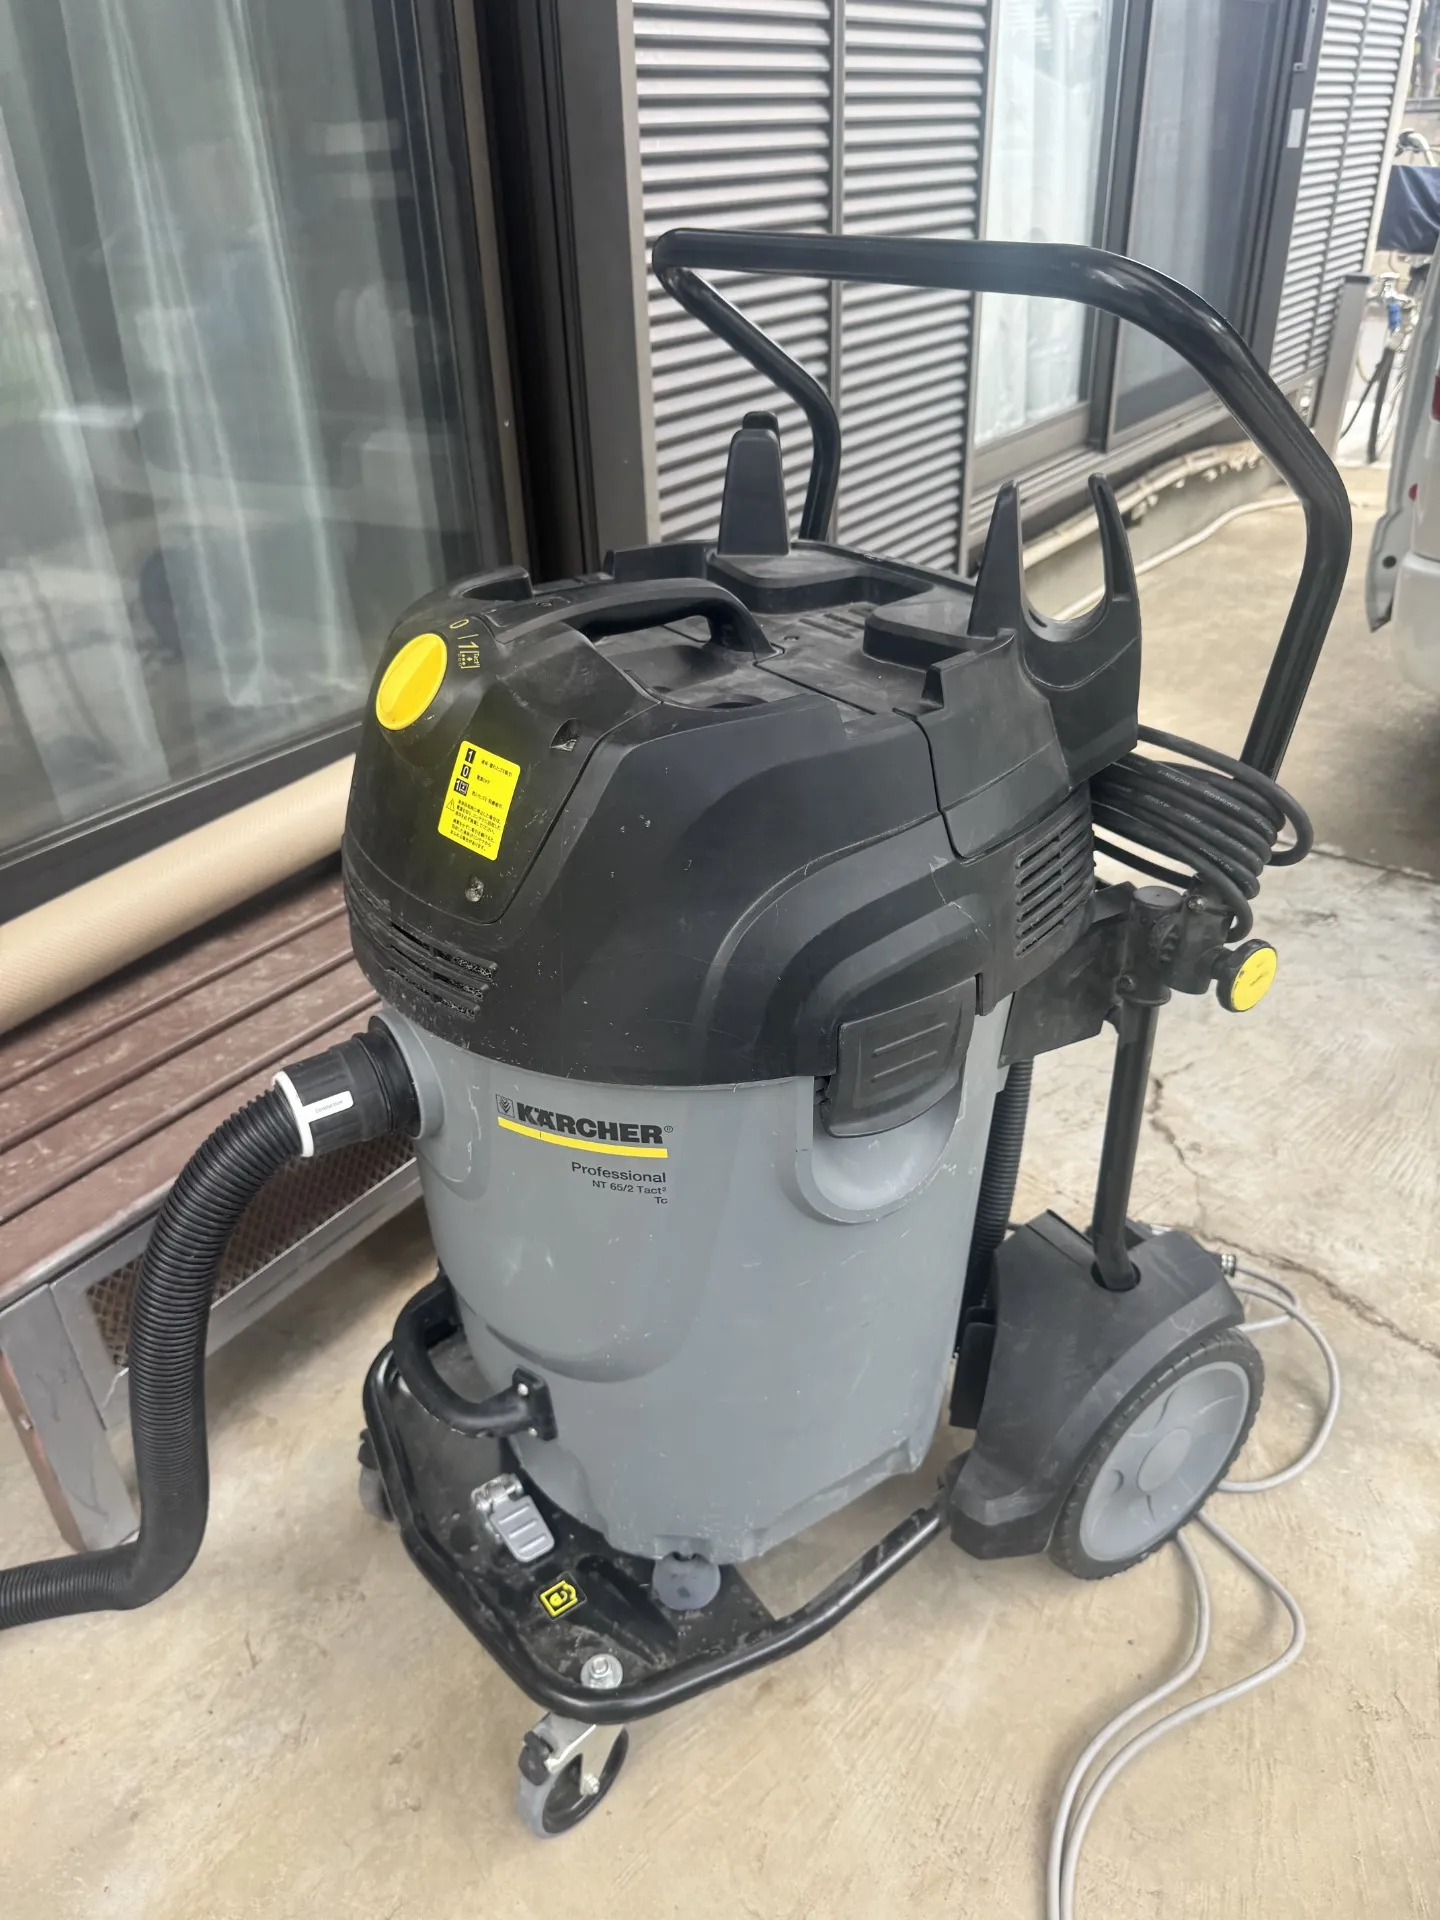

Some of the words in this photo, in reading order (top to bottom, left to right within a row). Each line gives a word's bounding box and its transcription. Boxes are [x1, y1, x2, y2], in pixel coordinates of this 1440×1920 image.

[466, 750, 474, 763] 1
[462, 765, 470, 778] 0
[571, 1161, 667, 1183] Professional
[592, 1179, 607, 1190] NT
[610, 1182, 634, 1193] 65/2
[654, 1197, 668, 1205] Tc
